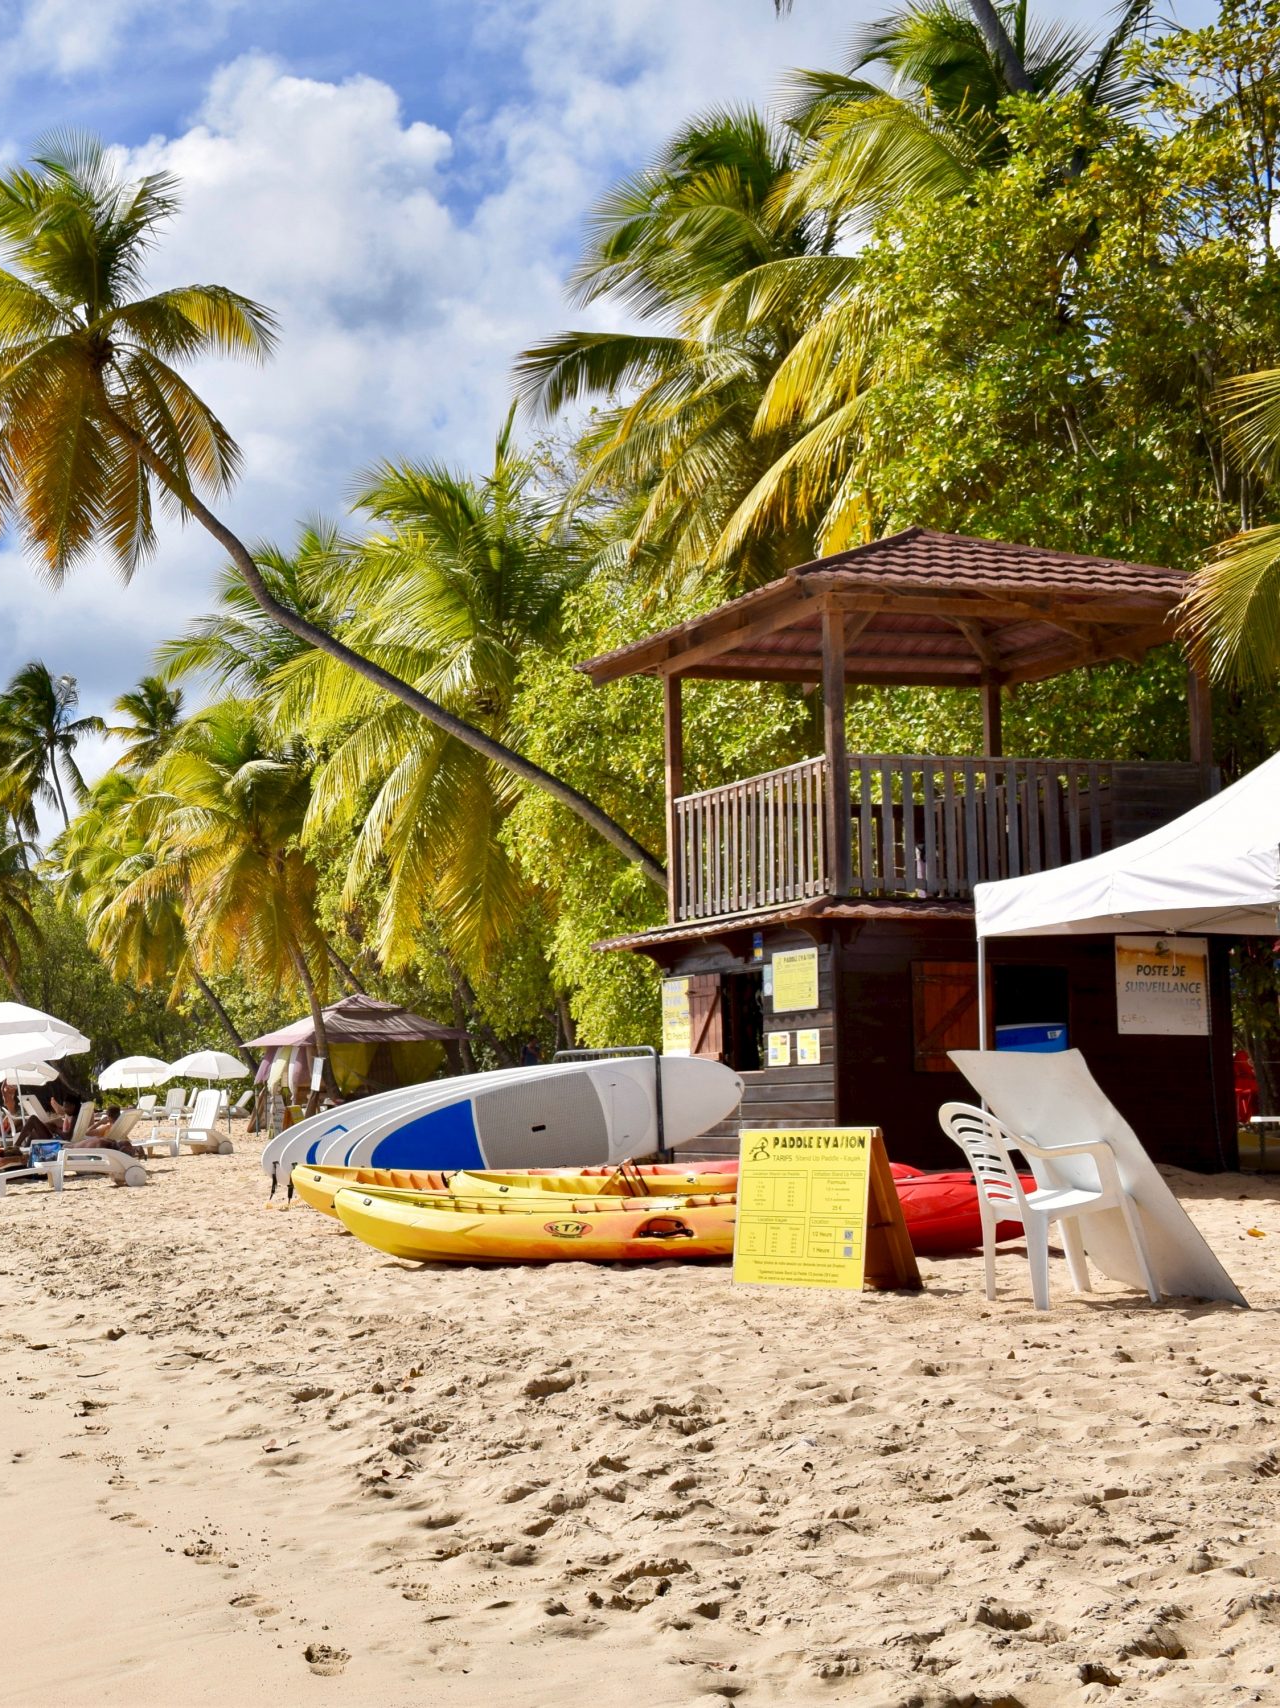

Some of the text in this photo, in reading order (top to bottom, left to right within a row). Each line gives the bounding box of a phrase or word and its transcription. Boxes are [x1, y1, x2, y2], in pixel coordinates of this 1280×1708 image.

[1136, 964, 1186, 977] POSTE DE
[1125, 981, 1201, 993] SURVEILLANCE
[773, 1136, 866, 1149] PADDLE EVASION
[772, 1154, 793, 1162] TARIFS
